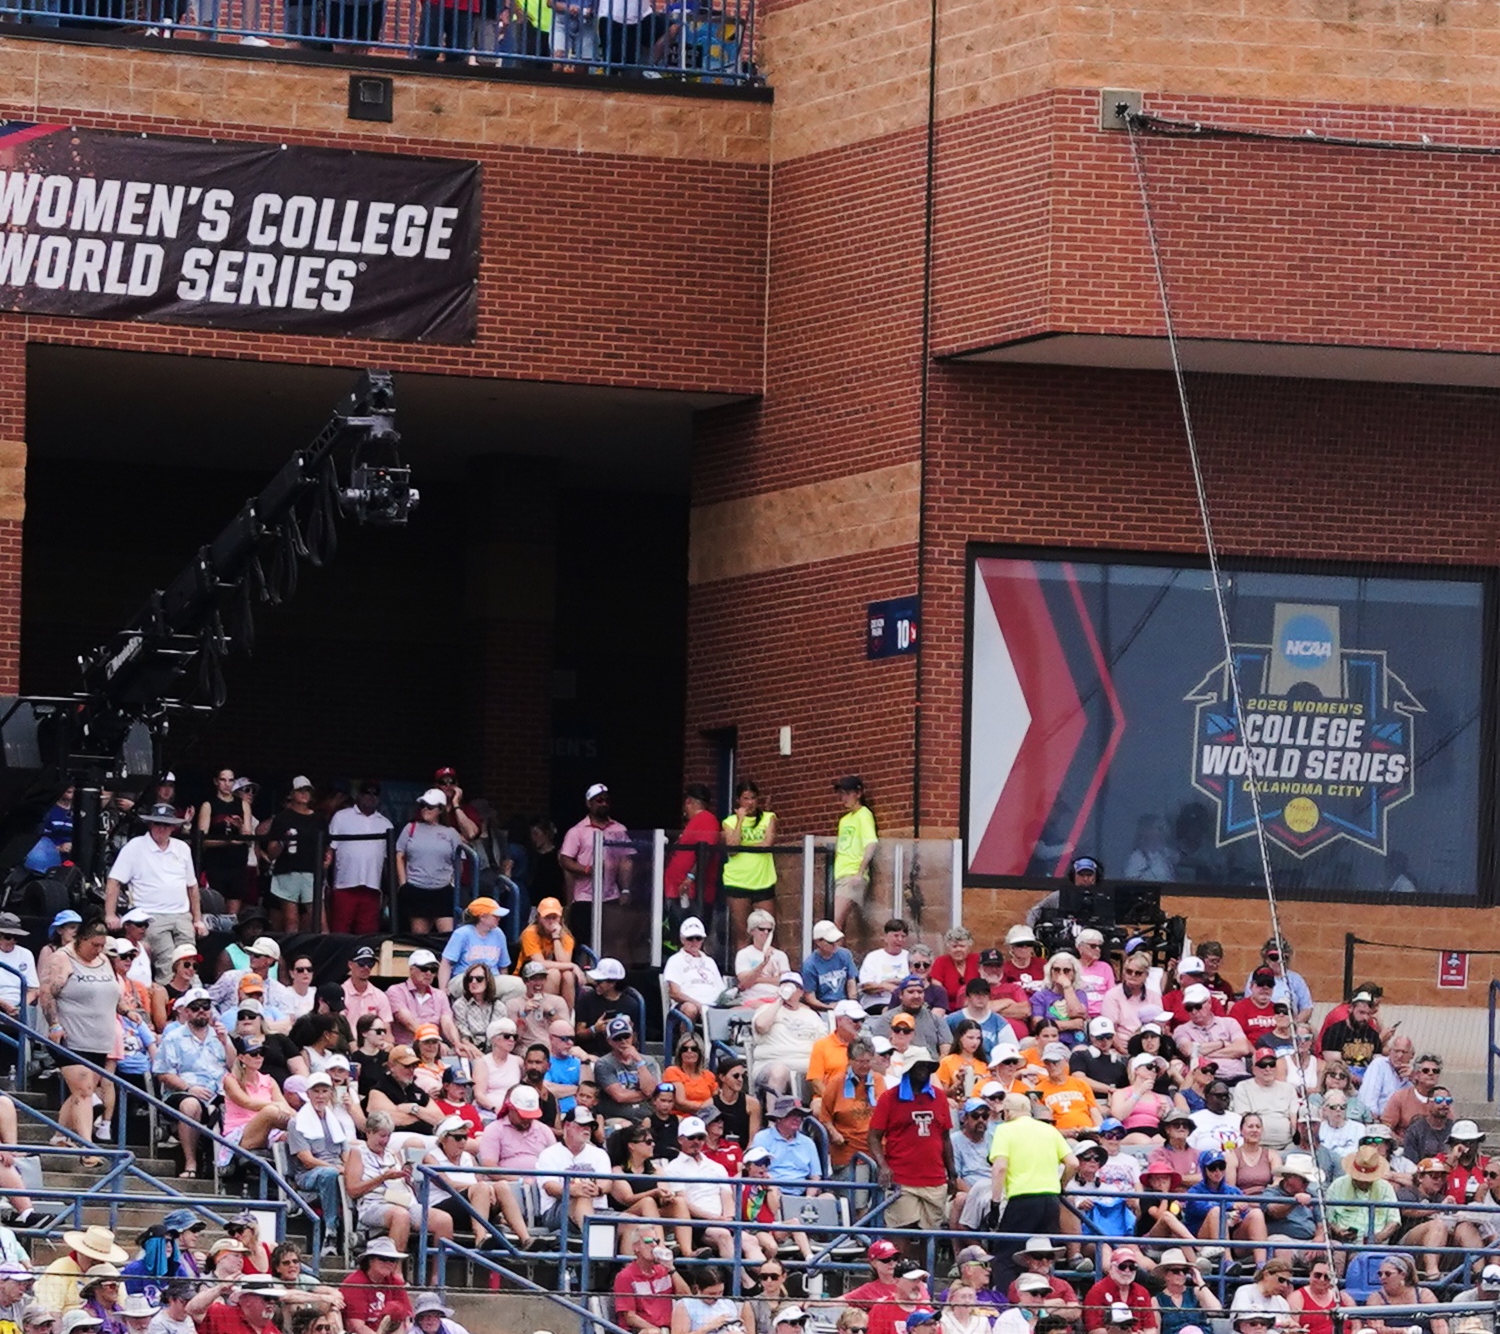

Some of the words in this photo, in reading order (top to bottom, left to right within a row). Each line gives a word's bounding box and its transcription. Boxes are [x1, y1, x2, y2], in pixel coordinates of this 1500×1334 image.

[0, 171, 236, 244] WOMEN'S
[246, 192, 459, 261] COLLEGE
[0, 231, 164, 298] WORLD
[177, 248, 361, 313] SERIES
[896, 619, 910, 649] 10
[1285, 640, 1333, 657] NCAA
[1247, 698, 1288, 713] 2026
[1292, 700, 1364, 715] WOMEN'S
[1246, 713, 1366, 748] COLLEGE
[551, 739, 597, 758] EN'S
[1201, 744, 1301, 779] WORLD
[1304, 750, 1407, 784] SERIES
[1242, 777, 1324, 796] OKLAHOMA
[1327, 784, 1365, 798] CITY
